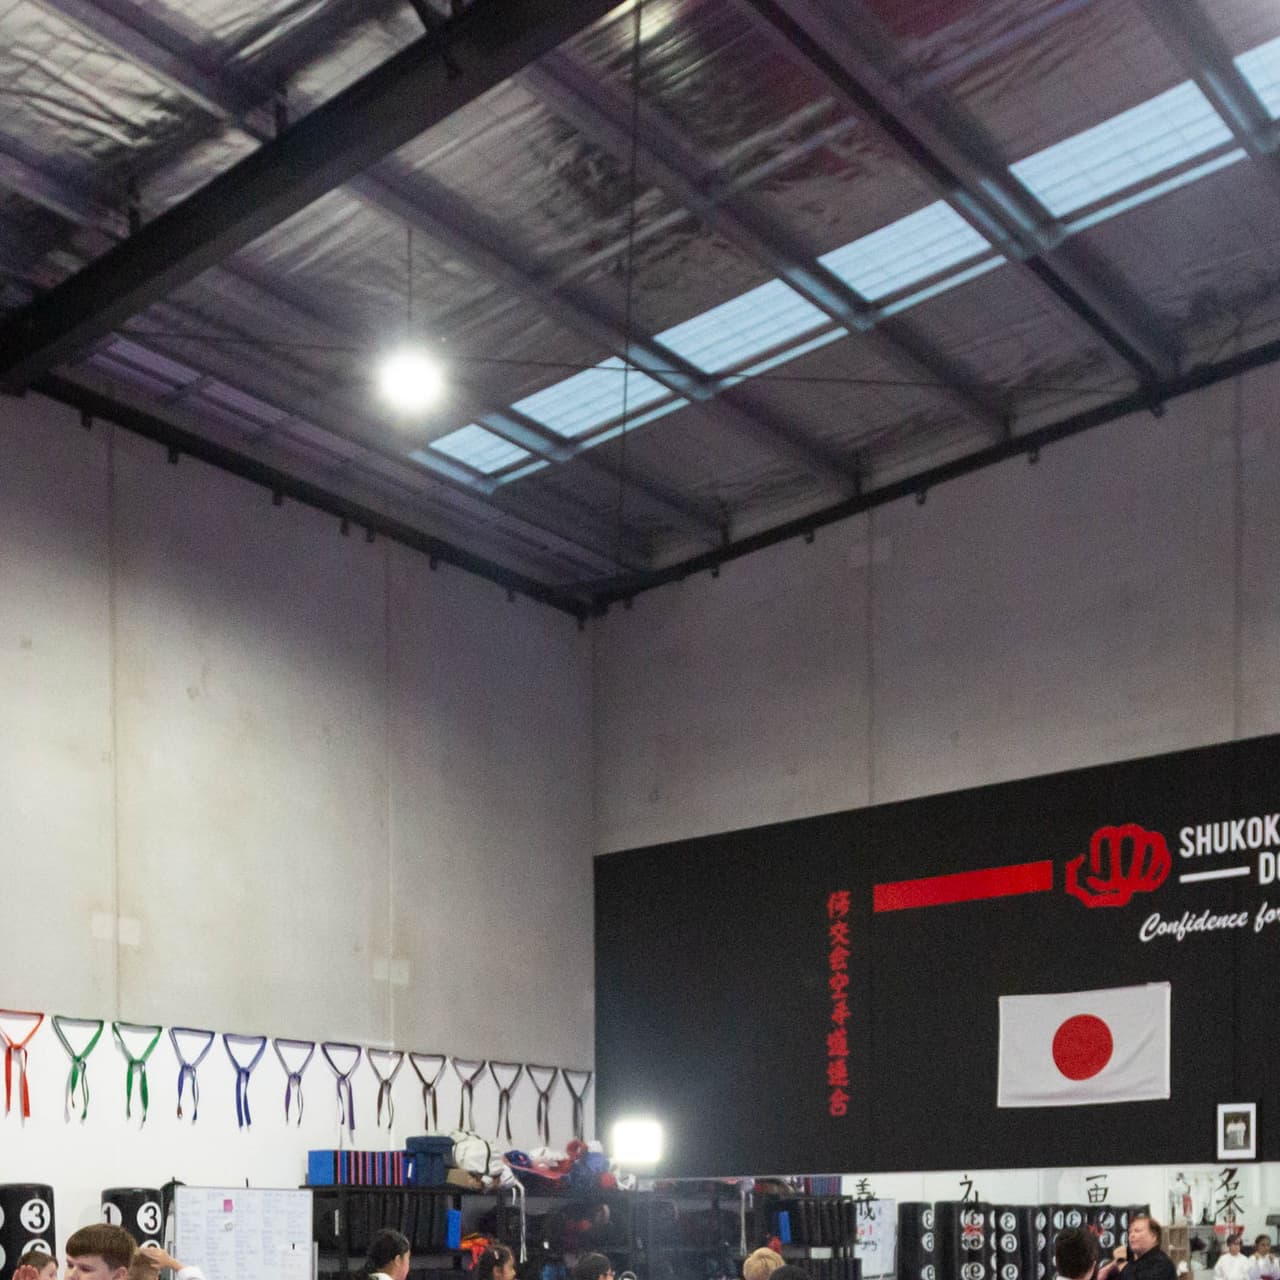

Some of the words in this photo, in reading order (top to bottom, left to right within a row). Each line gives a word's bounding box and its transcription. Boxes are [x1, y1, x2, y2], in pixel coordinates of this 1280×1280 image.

[1137, 908, 1249, 942] Confidence
[28, 1203, 45, 1230] 3
[143, 1207, 158, 1231] 3
